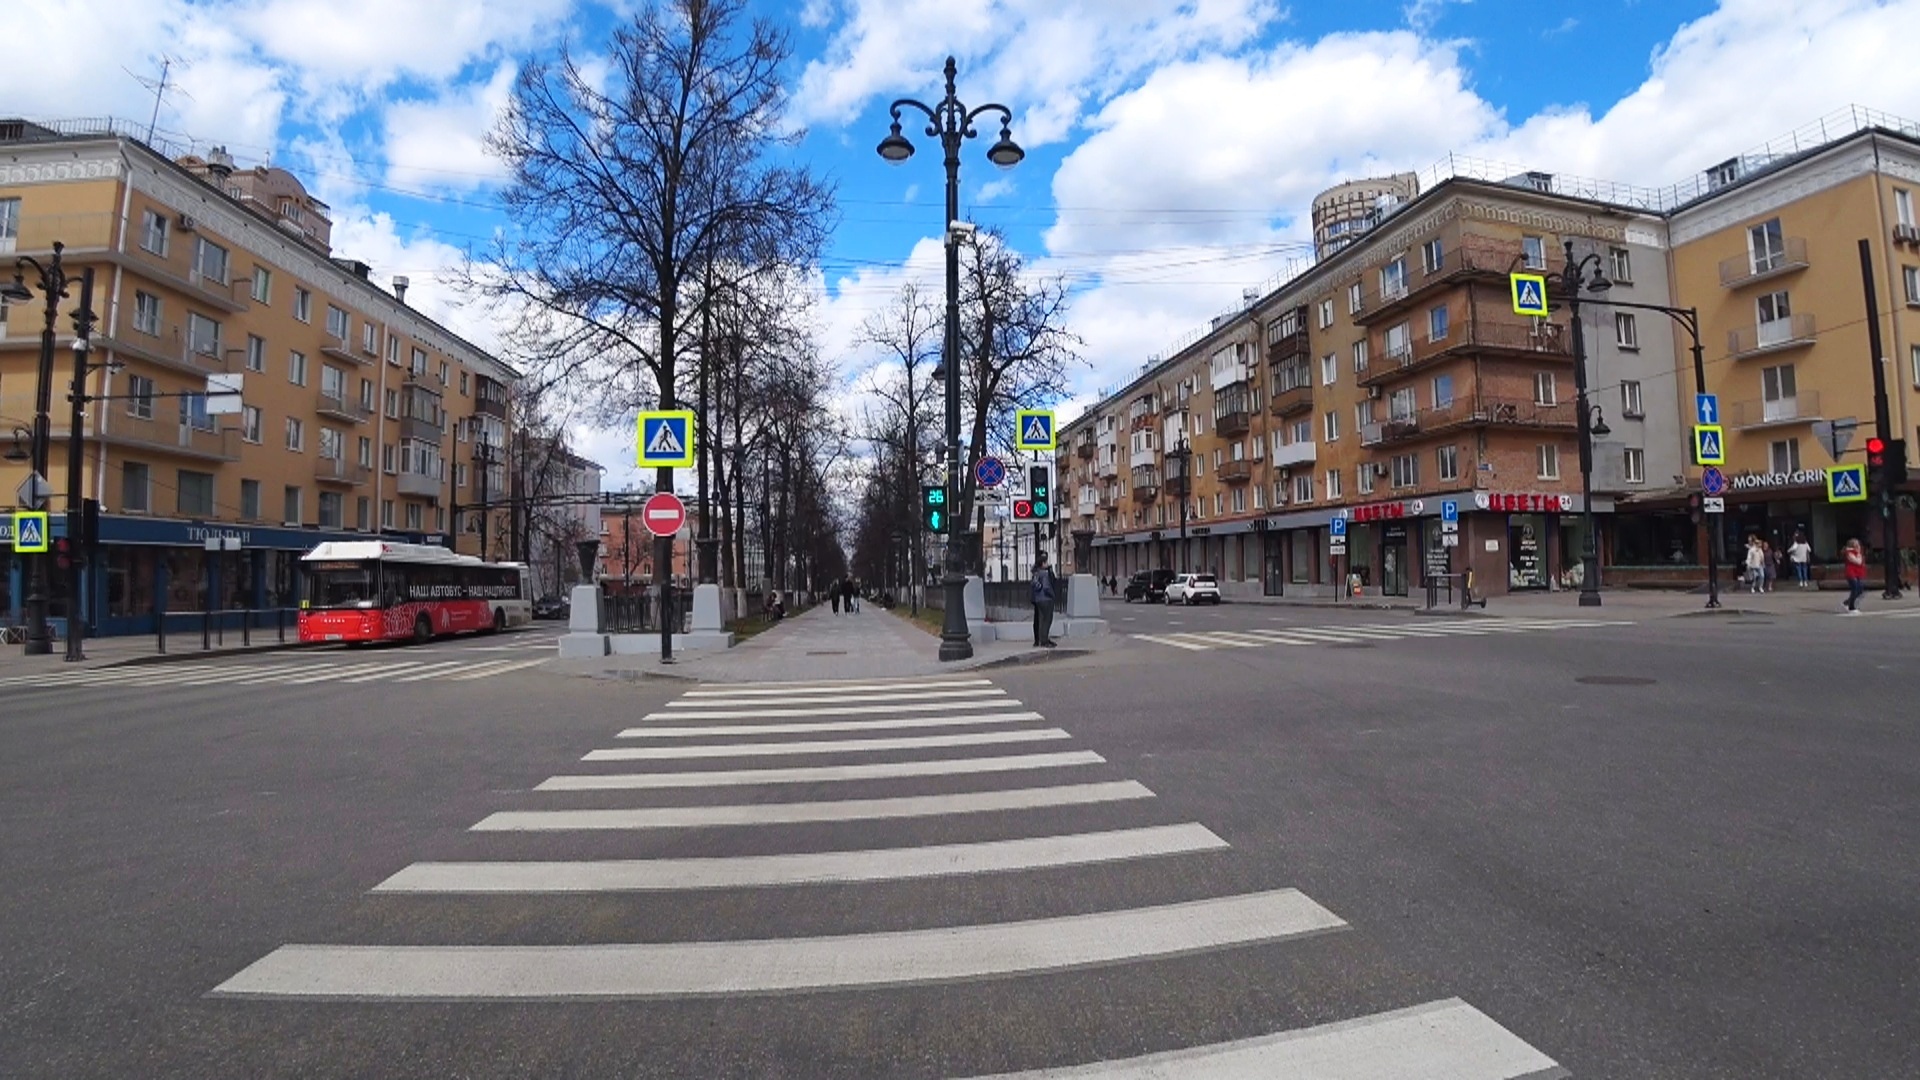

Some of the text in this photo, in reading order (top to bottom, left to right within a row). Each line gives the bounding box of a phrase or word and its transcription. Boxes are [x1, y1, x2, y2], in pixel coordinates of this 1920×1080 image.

[1733, 472, 1791, 490] MONKEY
[928, 489, 944, 504] 26
[1489, 493, 1560, 512] ЦВЕТЫ
[1354, 501, 1405, 522] ЦВЕТЫ
[187, 527, 251, 543] ТЮЛЬПАН
[409, 585, 429, 598] НАШ
[430, 585, 462, 598] АВТОБУС
[468, 586, 483, 597] НАШ
